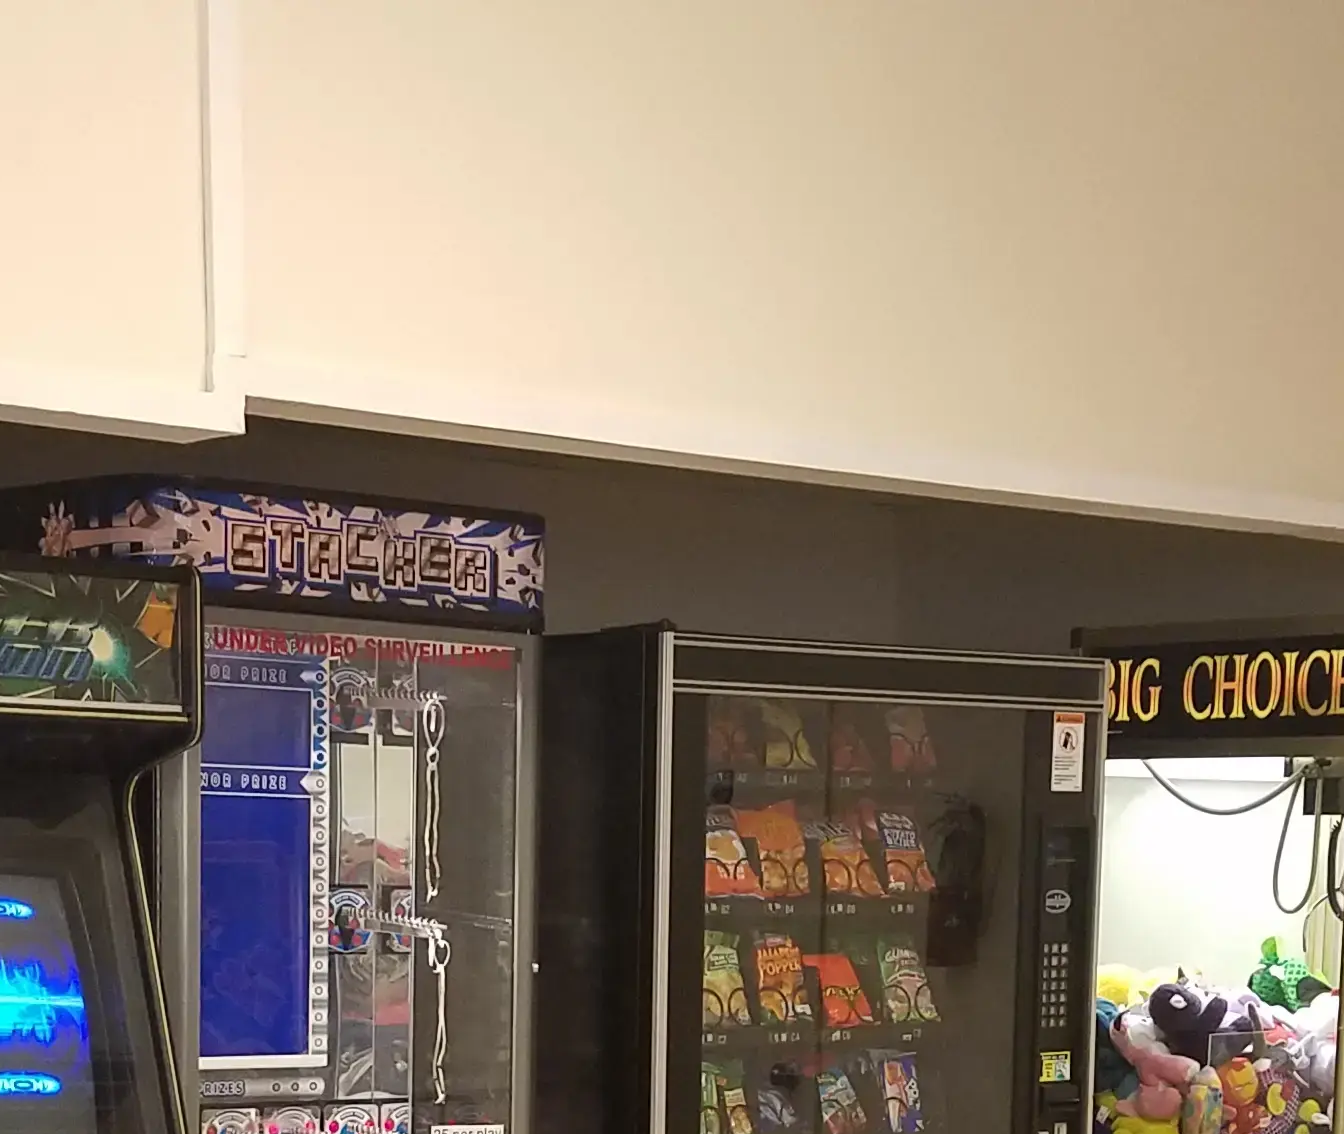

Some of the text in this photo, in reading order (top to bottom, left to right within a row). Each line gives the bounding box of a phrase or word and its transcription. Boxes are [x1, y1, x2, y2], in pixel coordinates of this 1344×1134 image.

[229, 519, 492, 596] STACKER
[212, 626, 288, 653] UNDER
[294, 633, 357, 658] VIDEO
[240, 665, 287, 684] PRIZE
[240, 773, 287, 790] PRIZE
